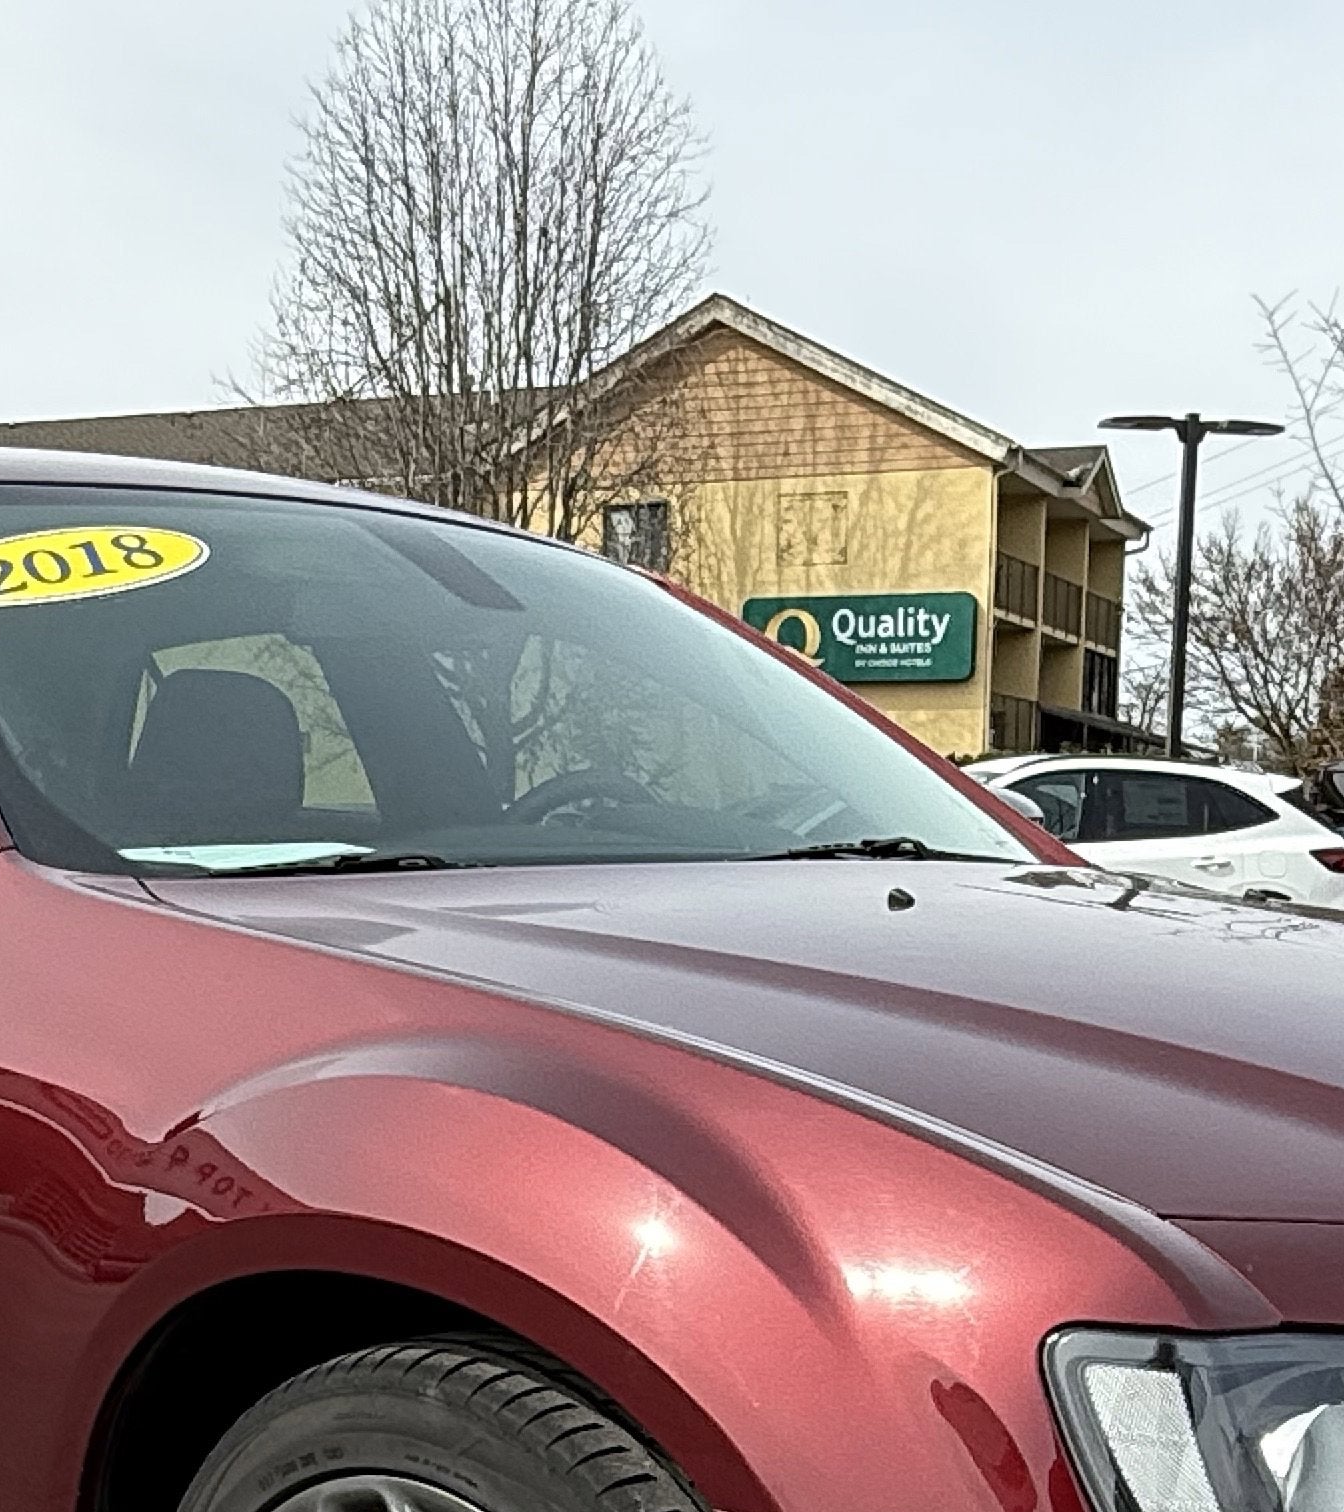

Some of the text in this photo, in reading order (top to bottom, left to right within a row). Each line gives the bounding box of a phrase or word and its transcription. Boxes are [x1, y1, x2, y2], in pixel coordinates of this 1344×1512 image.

[832, 607, 951, 645] Quality
[855, 643, 877, 654] INN
[879, 643, 888, 653] &
